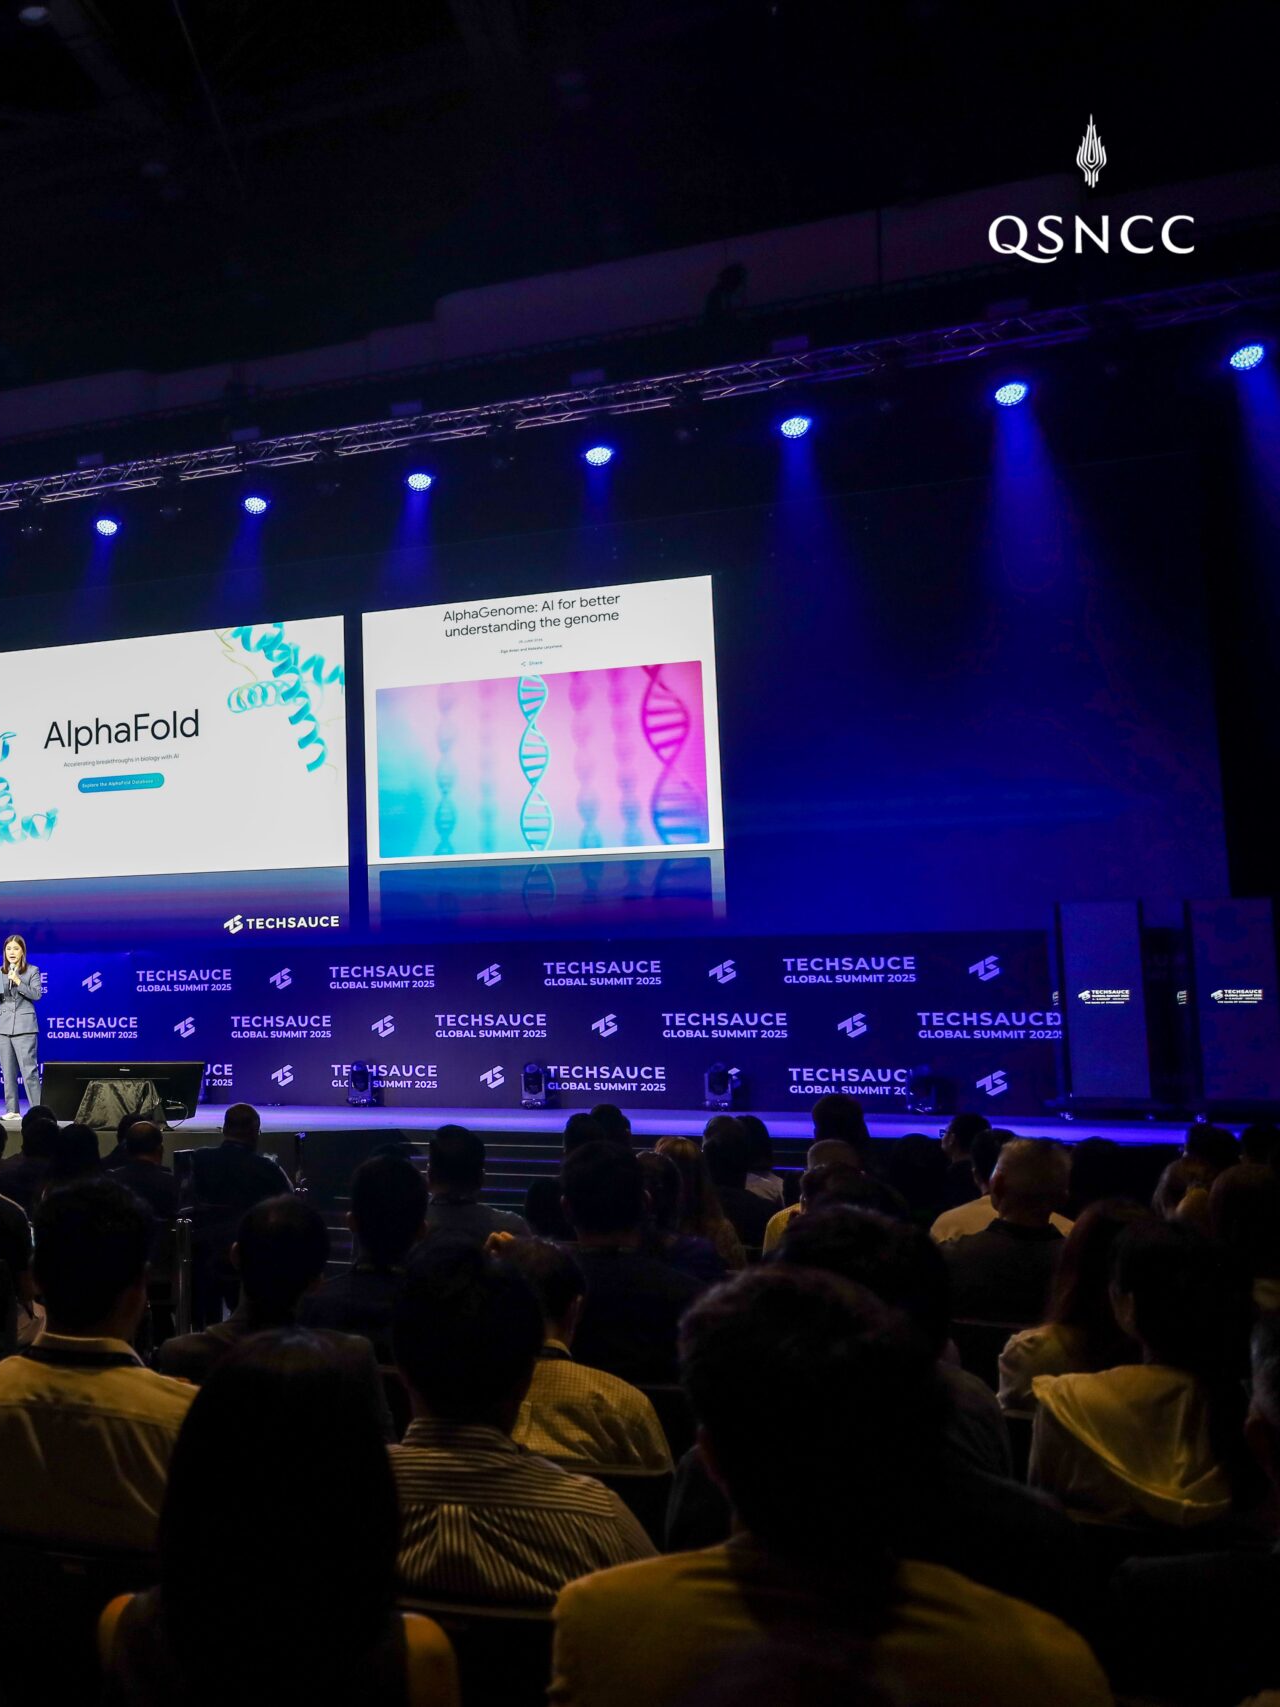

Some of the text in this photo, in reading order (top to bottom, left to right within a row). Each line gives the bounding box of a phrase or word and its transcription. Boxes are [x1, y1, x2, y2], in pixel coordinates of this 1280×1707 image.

[443, 594, 621, 623] AlphaGenome: AI for better
[445, 611, 619, 637] understanding the genome
[44, 709, 199, 754] AlphaFold
[140, 755, 160, 763] biology
[246, 915, 340, 930] TECHSAUCE
[543, 961, 662, 975] TECHSAUCE
[783, 957, 916, 972] TECHSAUCE
[136, 969, 232, 981] TECHSAUCE
[329, 965, 435, 979] TECHSAUCE
[329, 980, 435, 989] GLOBAL SUMMIT 2025
[544, 976, 662, 986] GLOBAL SUMMIT 2025
[784, 974, 916, 984] GLOBAL SUMMIT 2025
[136, 983, 232, 992] GLOBAL SUMMIT 2025
[47, 1017, 138, 1029] TECHSAUCE
[231, 1015, 332, 1028] TECHSAUCE
[435, 1014, 547, 1027] TECHSAUCE
[662, 1013, 788, 1026] TECHSAUCE
[47, 1031, 138, 1039] GLOBAL SUMMIT 2025
[231, 1030, 332, 1038] GLOBAL SUMMIT 2025
[435, 1029, 547, 1038] GLOBAL SUMMIT 2025
[662, 1029, 788, 1038] GLOBAL SUMMIT 2025
[918, 1029, 971, 1039] GLOBAL
[973, 1029, 1026, 1039] SUMMIT
[331, 1065, 438, 1077] TEHSAUCE
[547, 1066, 666, 1079] TECHSAUCE
[788, 1068, 907, 1082] TECHSAUC
[373, 1080, 412, 1088] SUMMIT
[548, 1082, 666, 1091] GLOBAL SUMMIT 2025
[789, 1085, 838, 1094] GLOBAL
[841, 1085, 891, 1095] SUMMIT
